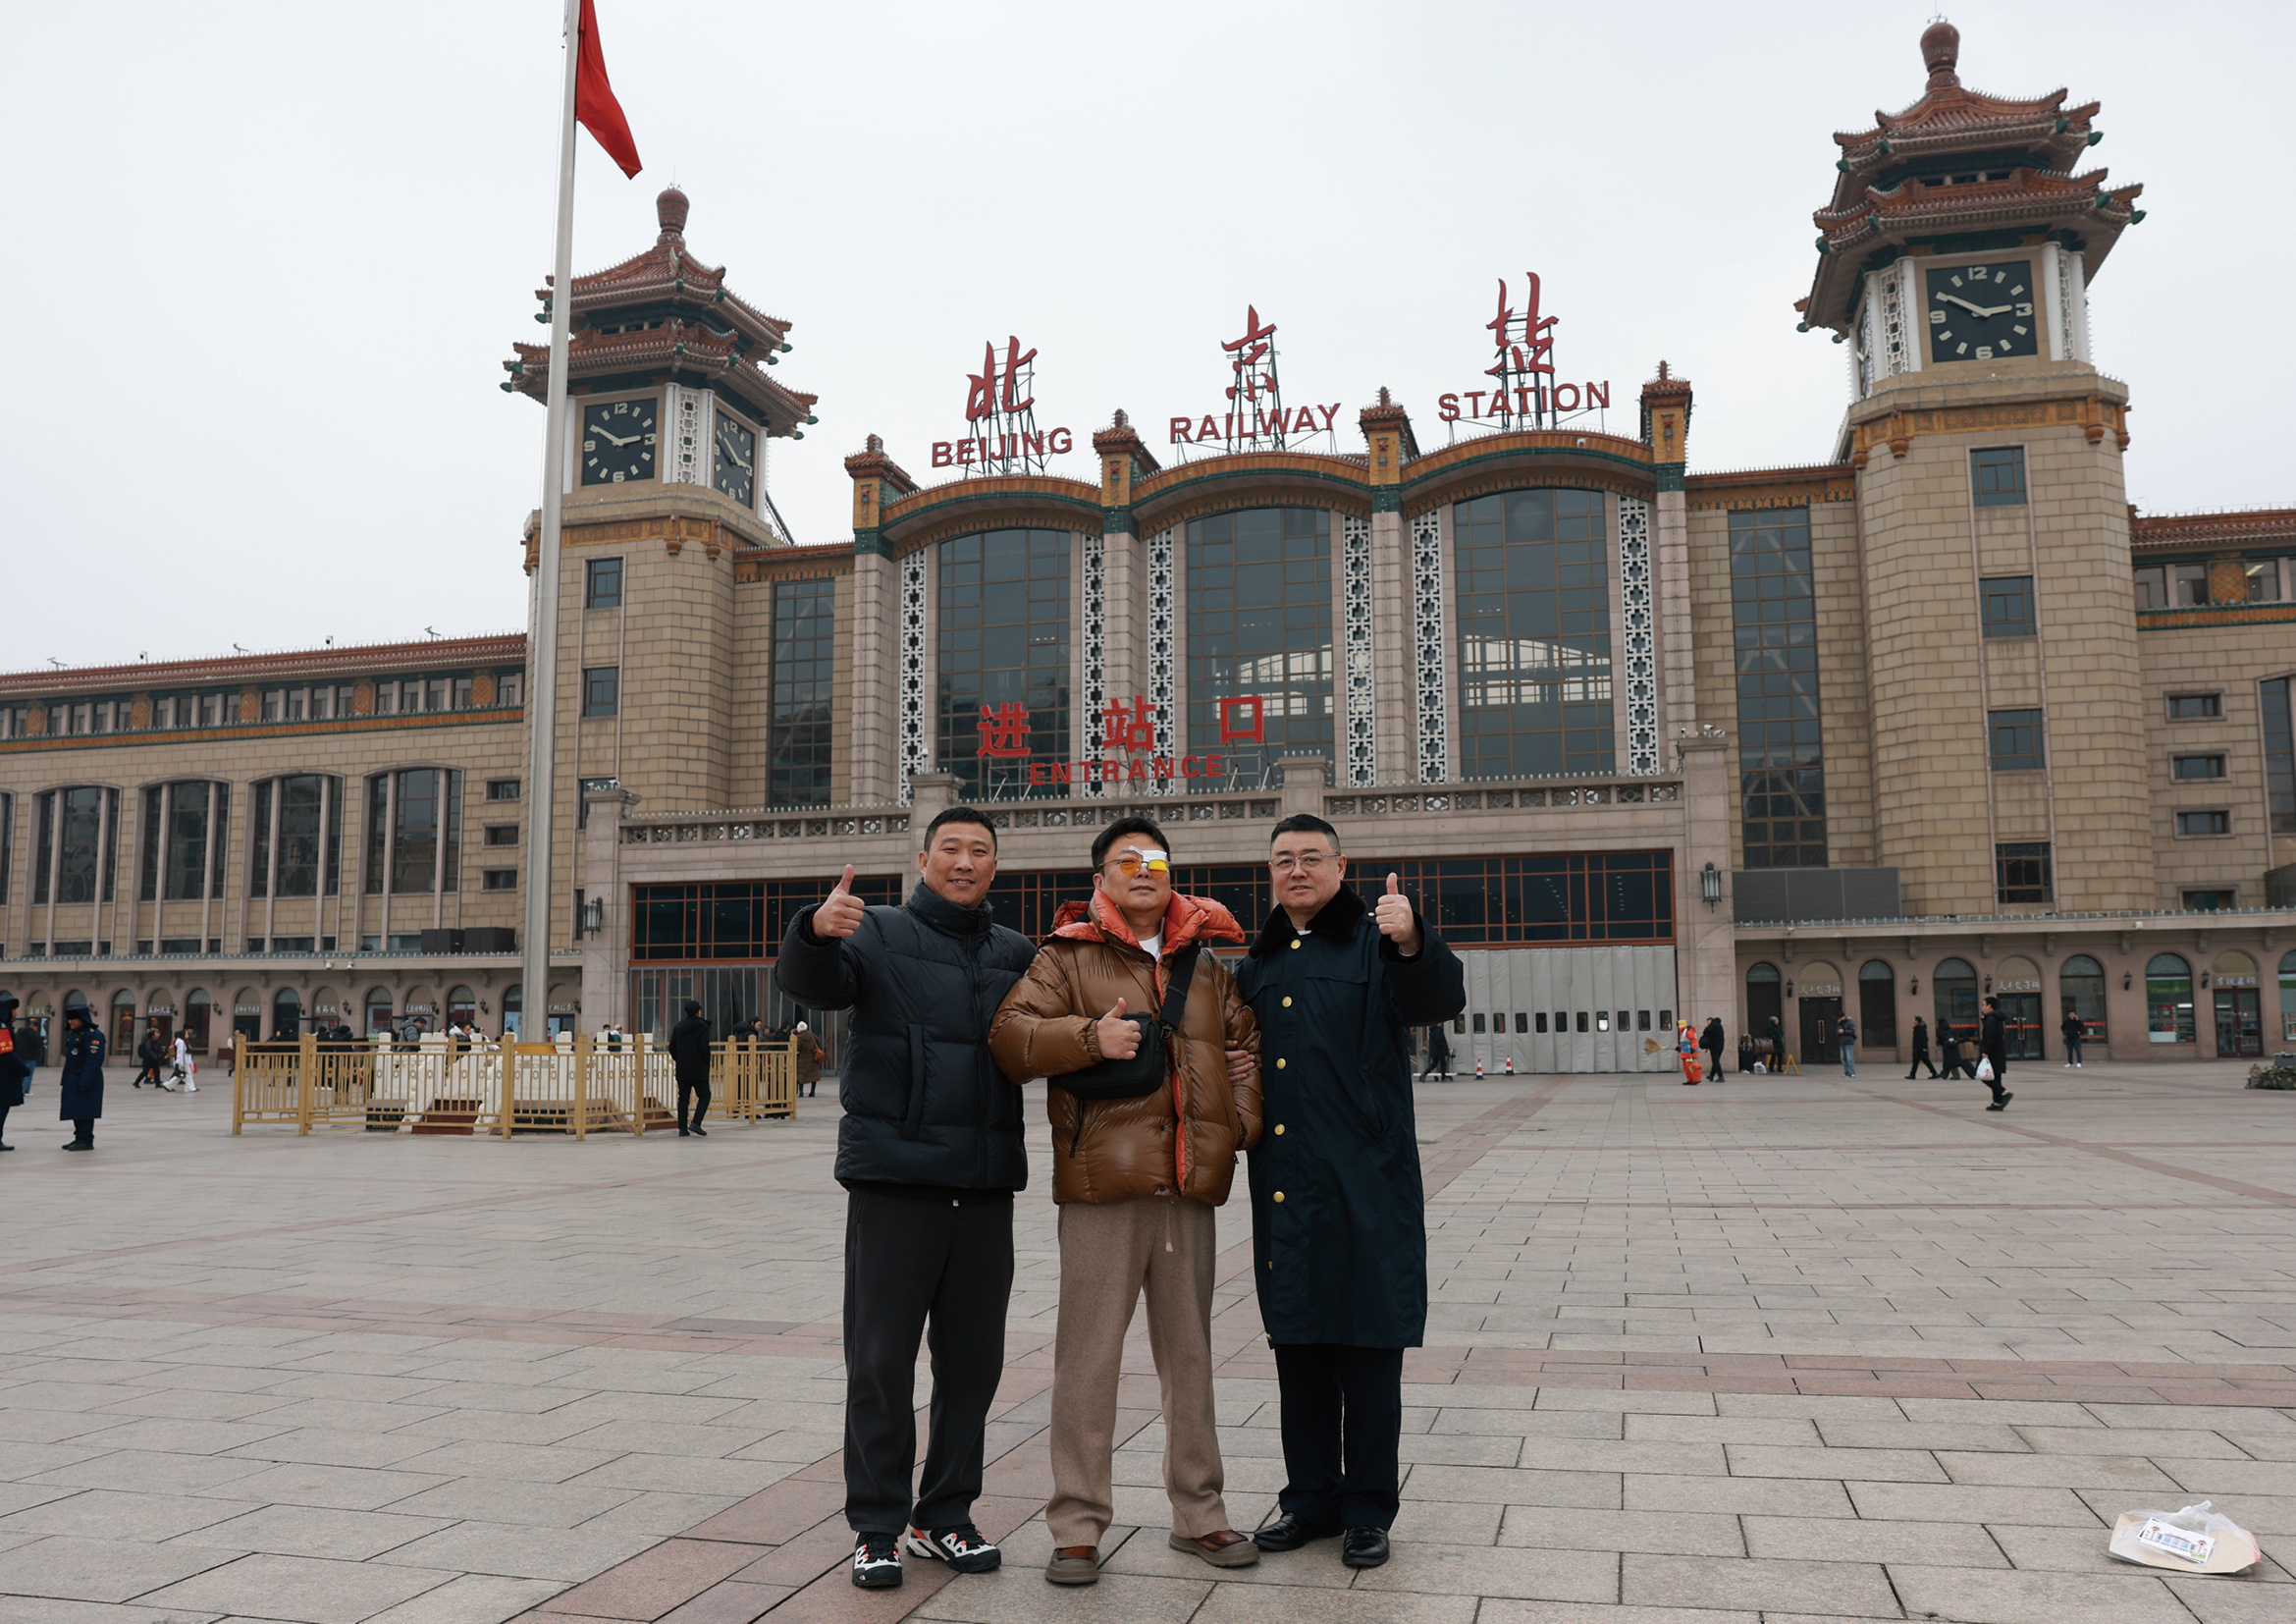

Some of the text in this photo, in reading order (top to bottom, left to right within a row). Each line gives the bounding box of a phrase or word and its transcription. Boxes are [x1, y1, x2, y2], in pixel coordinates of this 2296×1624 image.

[1968, 266, 1988, 280] 12
[1930, 309, 1947, 324] 9
[2015, 302, 2033, 317] 3
[1975, 346, 1993, 359] 6
[614, 403, 628, 414] 12
[933, 381, 1609, 467] BEIJING RAILWAY STATION
[584, 440, 596, 452] 9
[644, 433, 657, 445] 3
[613, 471, 624, 482] 6
[976, 695, 1265, 759] 进站口
[1031, 754, 1223, 785] ENTRANCE
